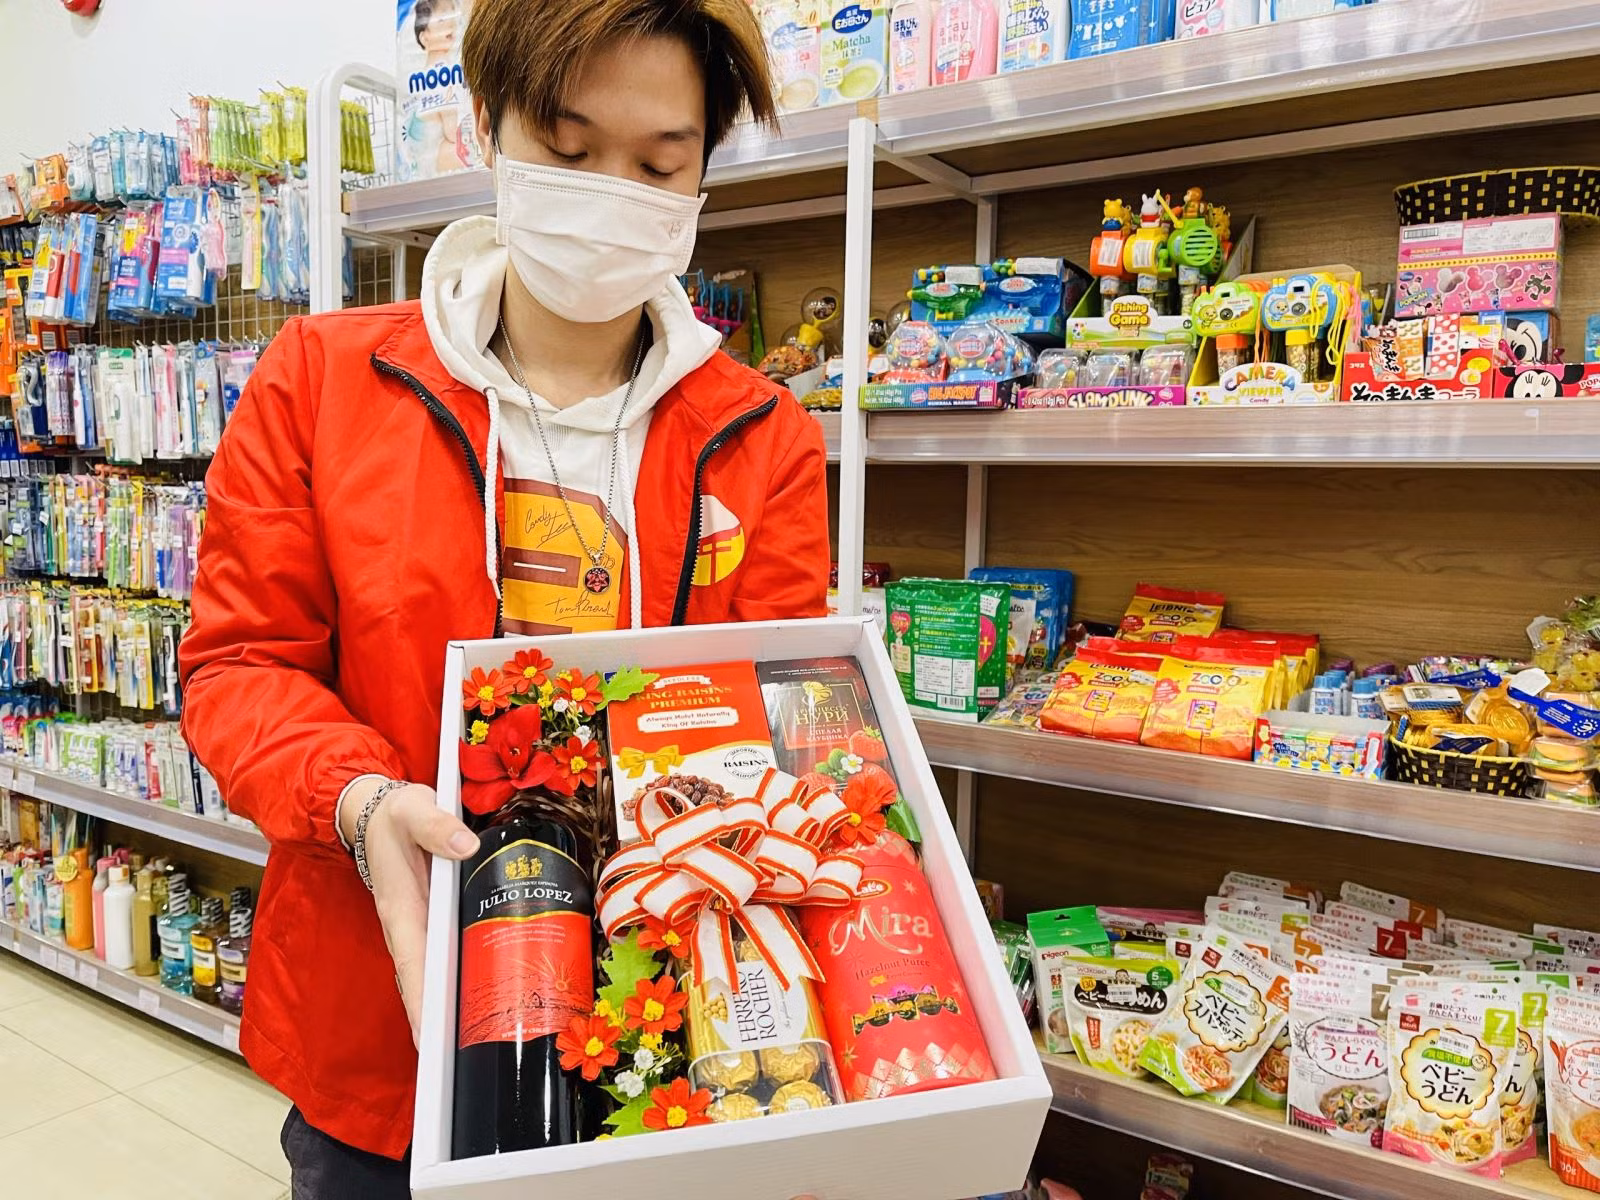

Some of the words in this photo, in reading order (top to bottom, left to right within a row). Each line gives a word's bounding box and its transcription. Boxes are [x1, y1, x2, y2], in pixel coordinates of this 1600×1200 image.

[939, 20, 969, 37] arau
[832, 34, 871, 52] Matcha
[409, 63, 467, 94] moon
[1113, 303, 1149, 314] Fishing
[1109, 312, 1150, 326] Game
[1225, 366, 1296, 392] CAMERA
[1580, 377, 1600, 389] POP
[1239, 387, 1285, 397] VIEWER
[1191, 672, 1223, 686] ZOO
[676, 686, 732, 698] RAISINS
[650, 696, 721, 709] PREMIUM
[794, 710, 850, 725] НУРИ
[723, 759, 769, 768] RAISINS
[477, 889, 520, 918] JULIO
[523, 887, 573, 905] LOPEZ
[828, 904, 934, 955] Mira
[1381, 933, 1394, 951] 7
[1041, 949, 1070, 961] pigeon
[855, 961, 901, 981] Hazelnut
[1151, 971, 1160, 981] 5
[748, 968, 778, 1040] ROCHER
[1205, 994, 1247, 1025] ベビー
[1375, 990, 1390, 1013] 7
[1529, 995, 1543, 1017] 7
[1494, 1012, 1510, 1034] 7
[1320, 1041, 1385, 1069] うどん
[1421, 1063, 1476, 1086] ベビー
[1421, 1079, 1474, 1106] うどん
